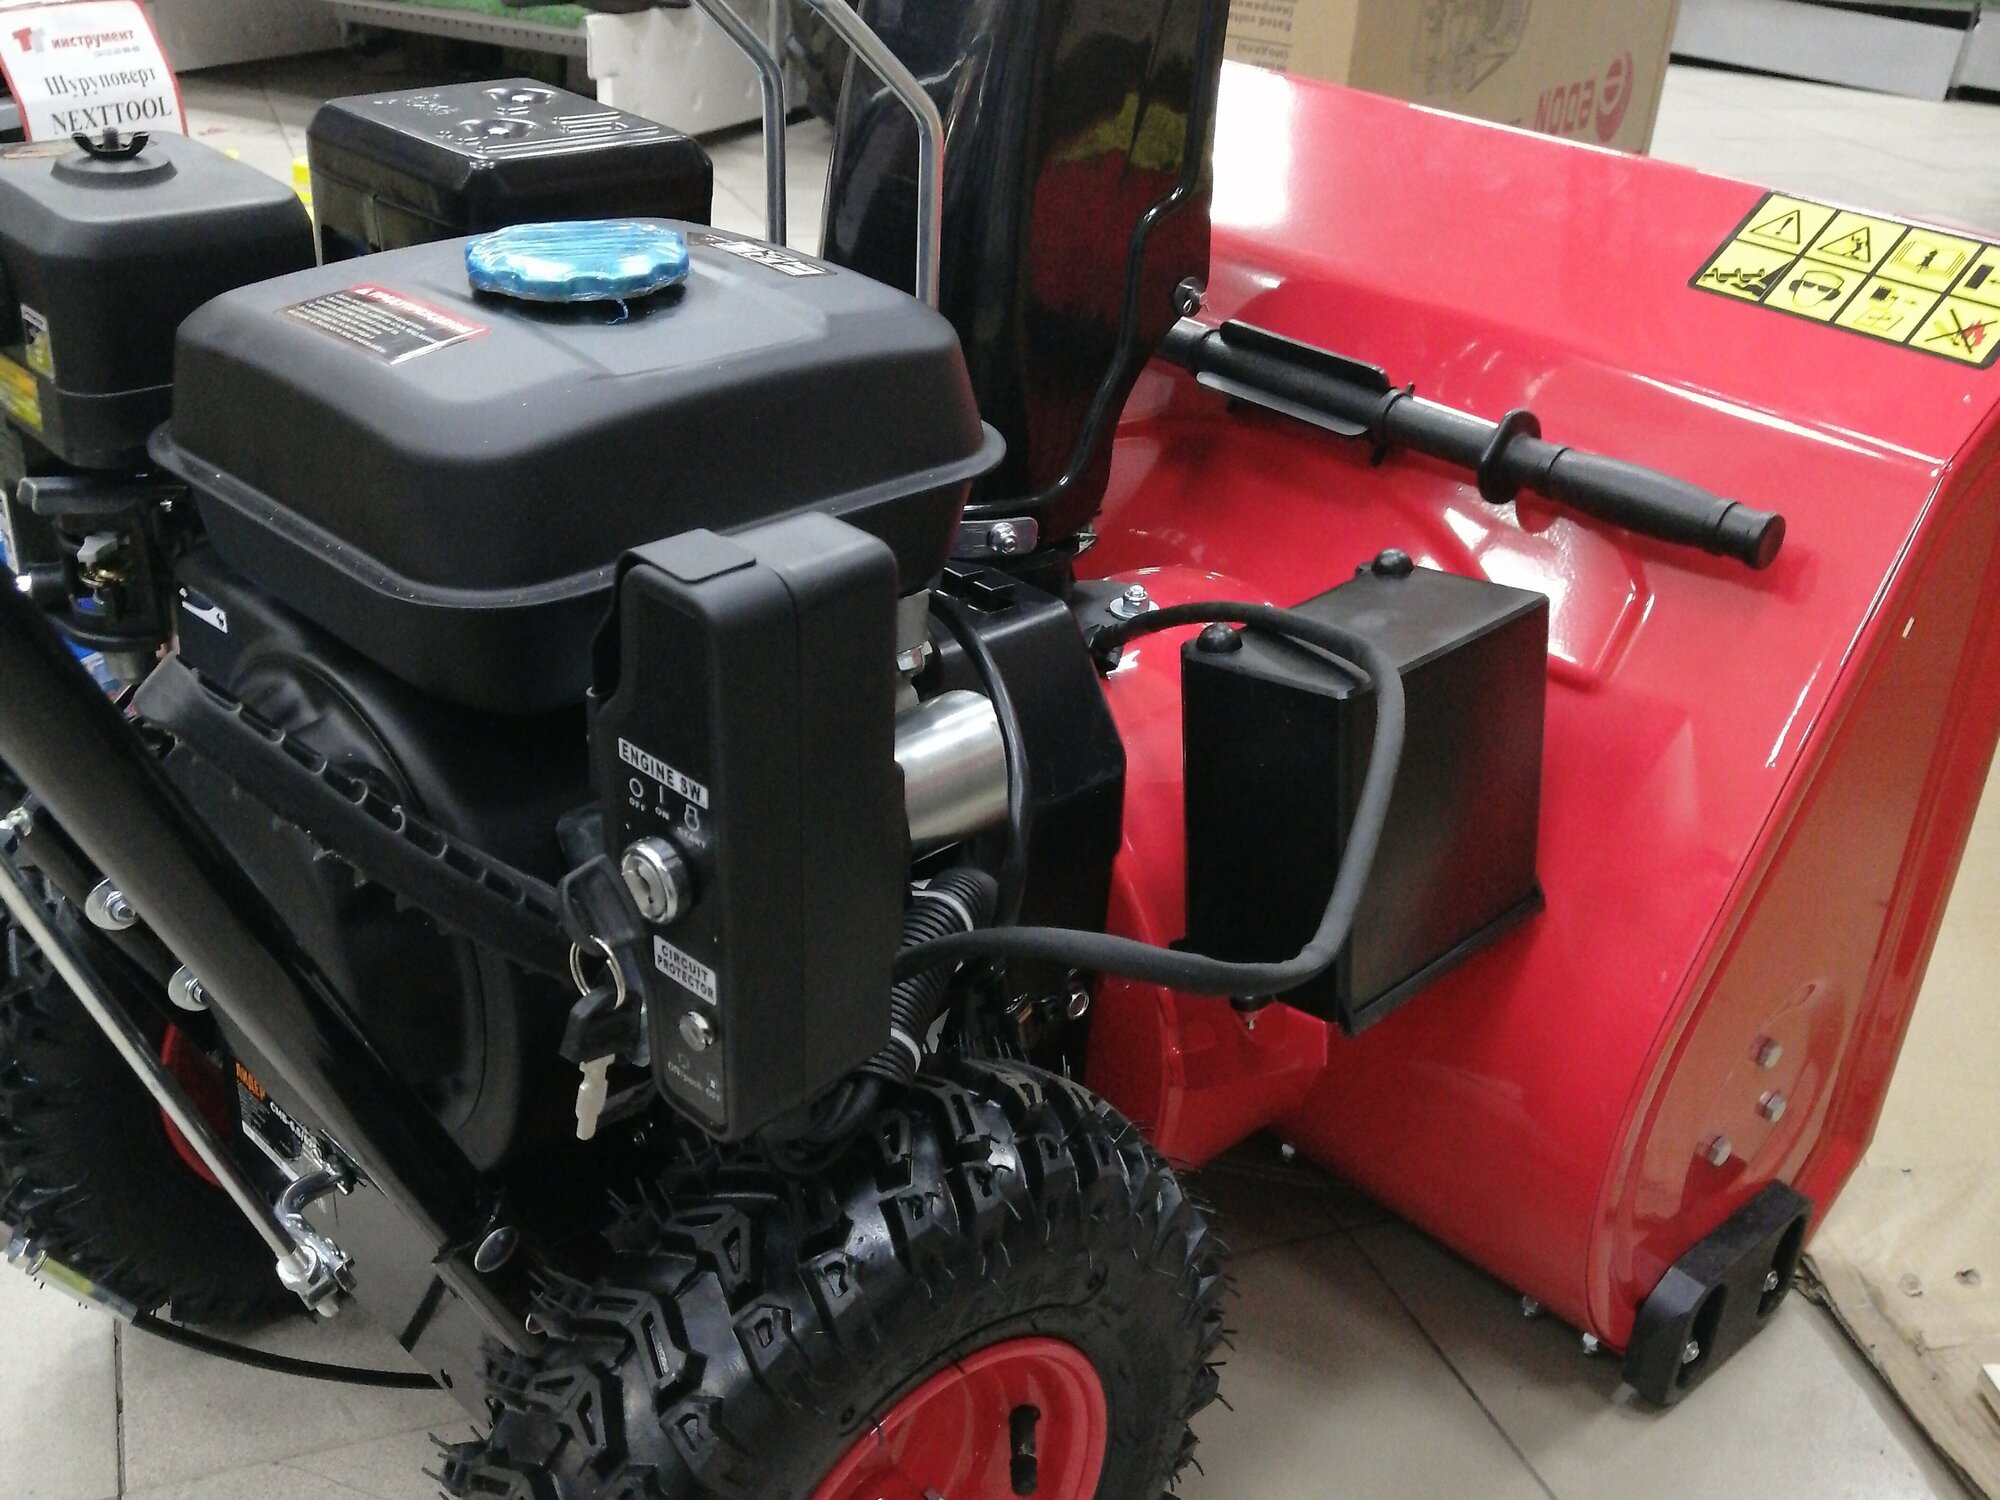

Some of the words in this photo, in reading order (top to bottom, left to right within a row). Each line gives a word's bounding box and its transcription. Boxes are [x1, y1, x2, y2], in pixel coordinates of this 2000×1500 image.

[52, 30, 134, 49] инструмент
[44, 67, 156, 98] Шуруповерт
[51, 96, 172, 135] NEXTTOOL
[622, 741, 675, 787] ENGINE
[679, 775, 701, 802] SW
[655, 806, 670, 820] ON
[656, 953, 715, 1000] PROTECTOR
[661, 944, 709, 978] CIRCUIT
